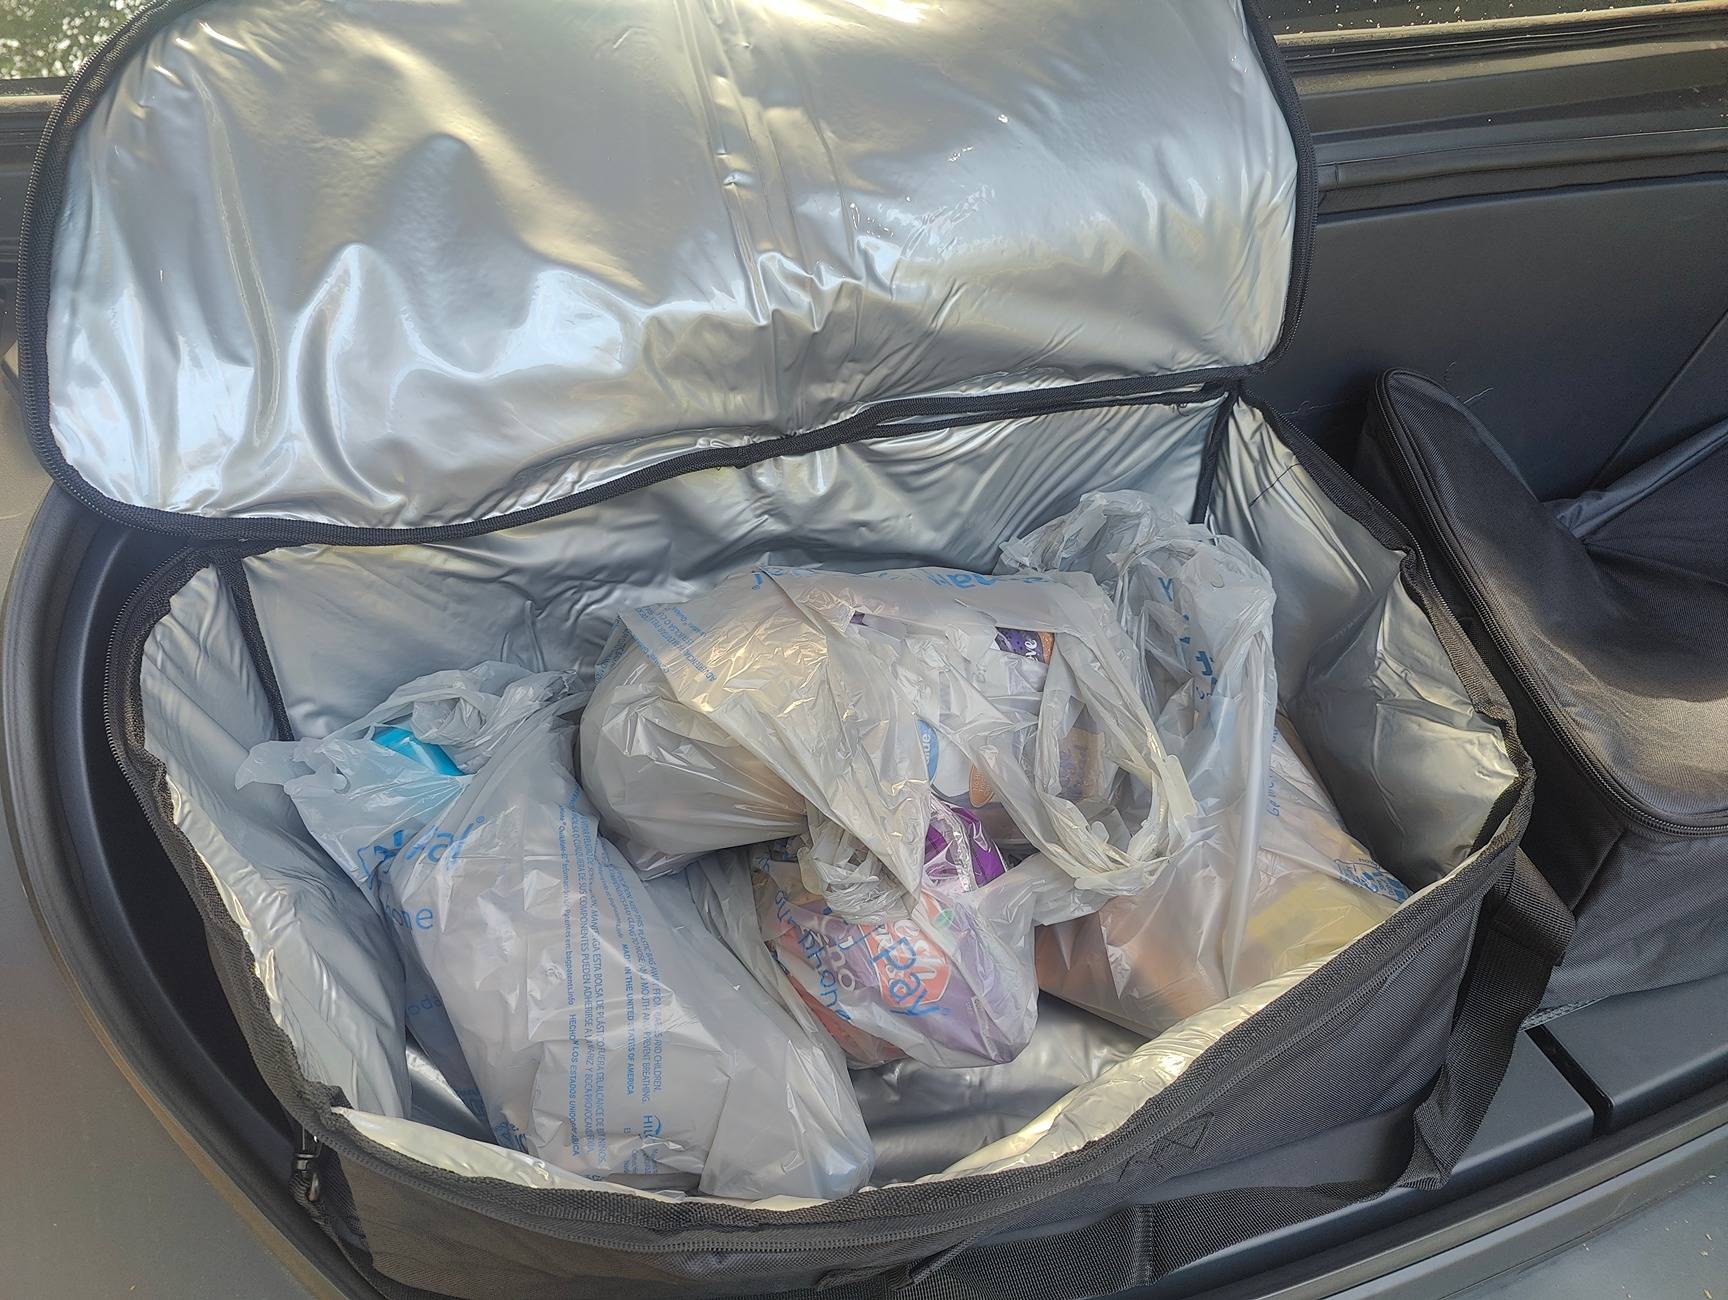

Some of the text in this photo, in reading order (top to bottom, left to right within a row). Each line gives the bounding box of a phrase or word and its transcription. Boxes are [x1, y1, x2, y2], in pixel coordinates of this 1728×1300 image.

[578, 882, 588, 895] SUS
[579, 896, 591, 952] COMPONENTES
[581, 953, 593, 985] PUEDEN
[592, 953, 603, 972] ESTA
[564, 951, 577, 1005] bagpatents.info
[593, 973, 605, 998] BOLSA
[625, 976, 634, 992] THE
[595, 1000, 605, 1011] DE
[626, 993, 636, 1021] UNITED
[568, 1014, 578, 1040] HECHO
[628, 1053, 637, 1063] OF
[654, 1039, 664, 1054] AND
[569, 1063, 578, 1099] ESTADOS
[627, 1063, 637, 1096] AMERICA
